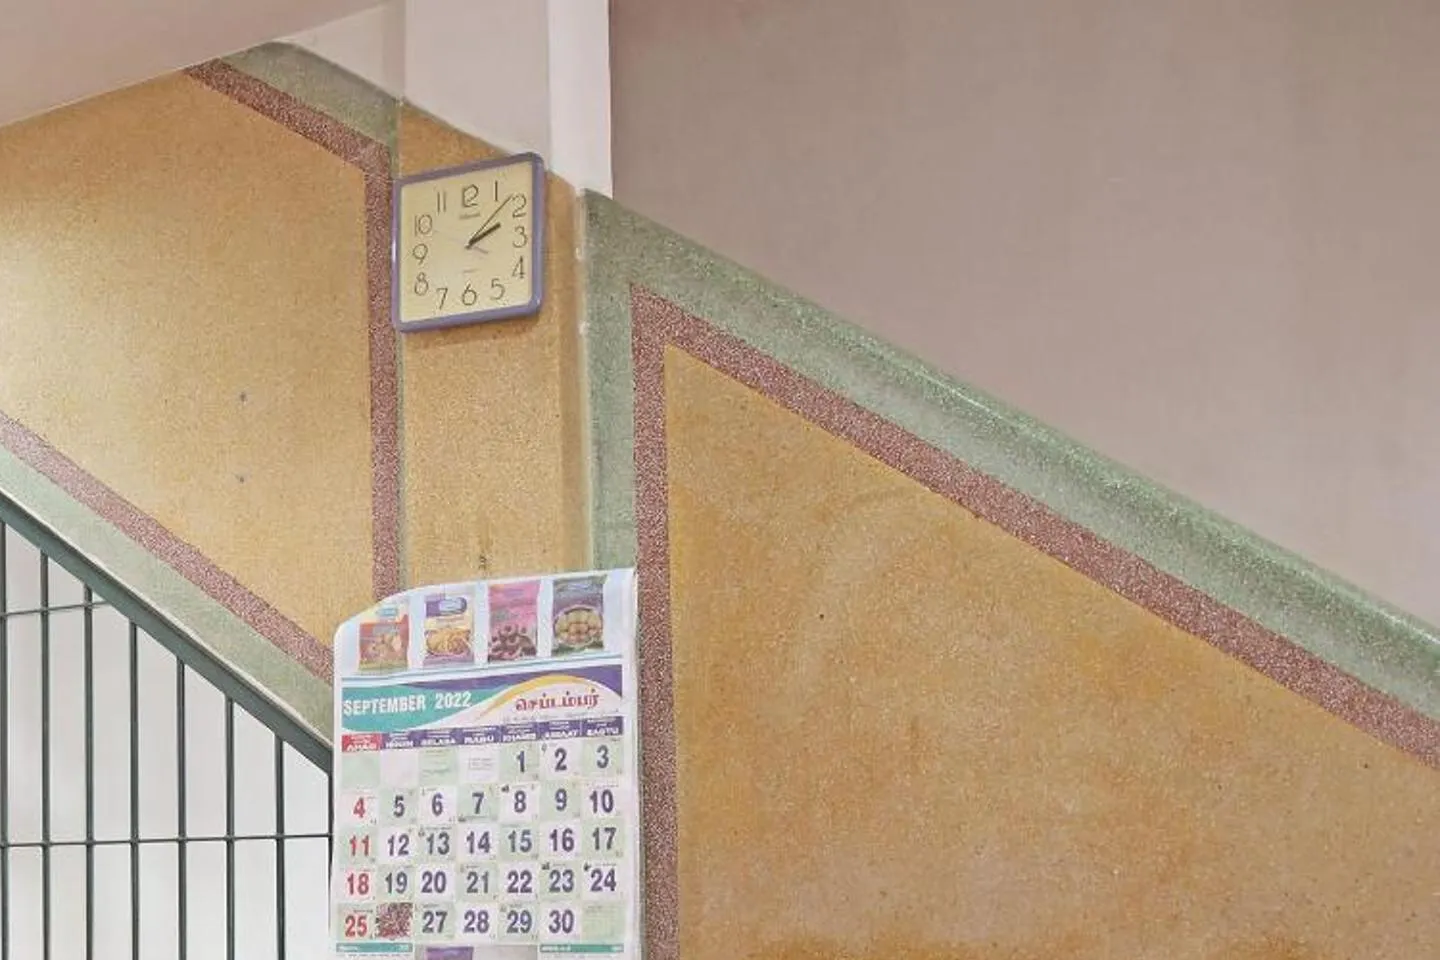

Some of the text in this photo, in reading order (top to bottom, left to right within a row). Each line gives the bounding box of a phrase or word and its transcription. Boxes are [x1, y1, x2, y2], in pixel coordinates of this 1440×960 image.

[437, 191, 447, 213] 11
[495, 180, 498, 202] 1
[511, 193, 527, 218] 2
[414, 214, 433, 236] 10
[512, 226, 528, 248] 3
[412, 243, 428, 265] 9
[512, 255, 526, 279] 4
[414, 272, 429, 296] 8
[462, 283, 478, 306] 6
[490, 278, 506, 300] 5
[436, 287, 448, 310] 7
[343, 691, 472, 715] SEPTEMBER 2022
[515, 750, 526, 773] 1
[554, 747, 568, 771] 2
[596, 745, 610, 768] 3
[352, 788, 614, 818] 4 5 6 7 8 9 10
[349, 827, 616, 856] 11 12 13 14 15 16 17
[347, 868, 616, 895] 18 19 20 21 22 23 24
[344, 914, 368, 936] 25
[422, 910, 447, 934] 27
[463, 910, 489, 933] 28
[507, 909, 532, 932] 29
[548, 909, 574, 933] 30
